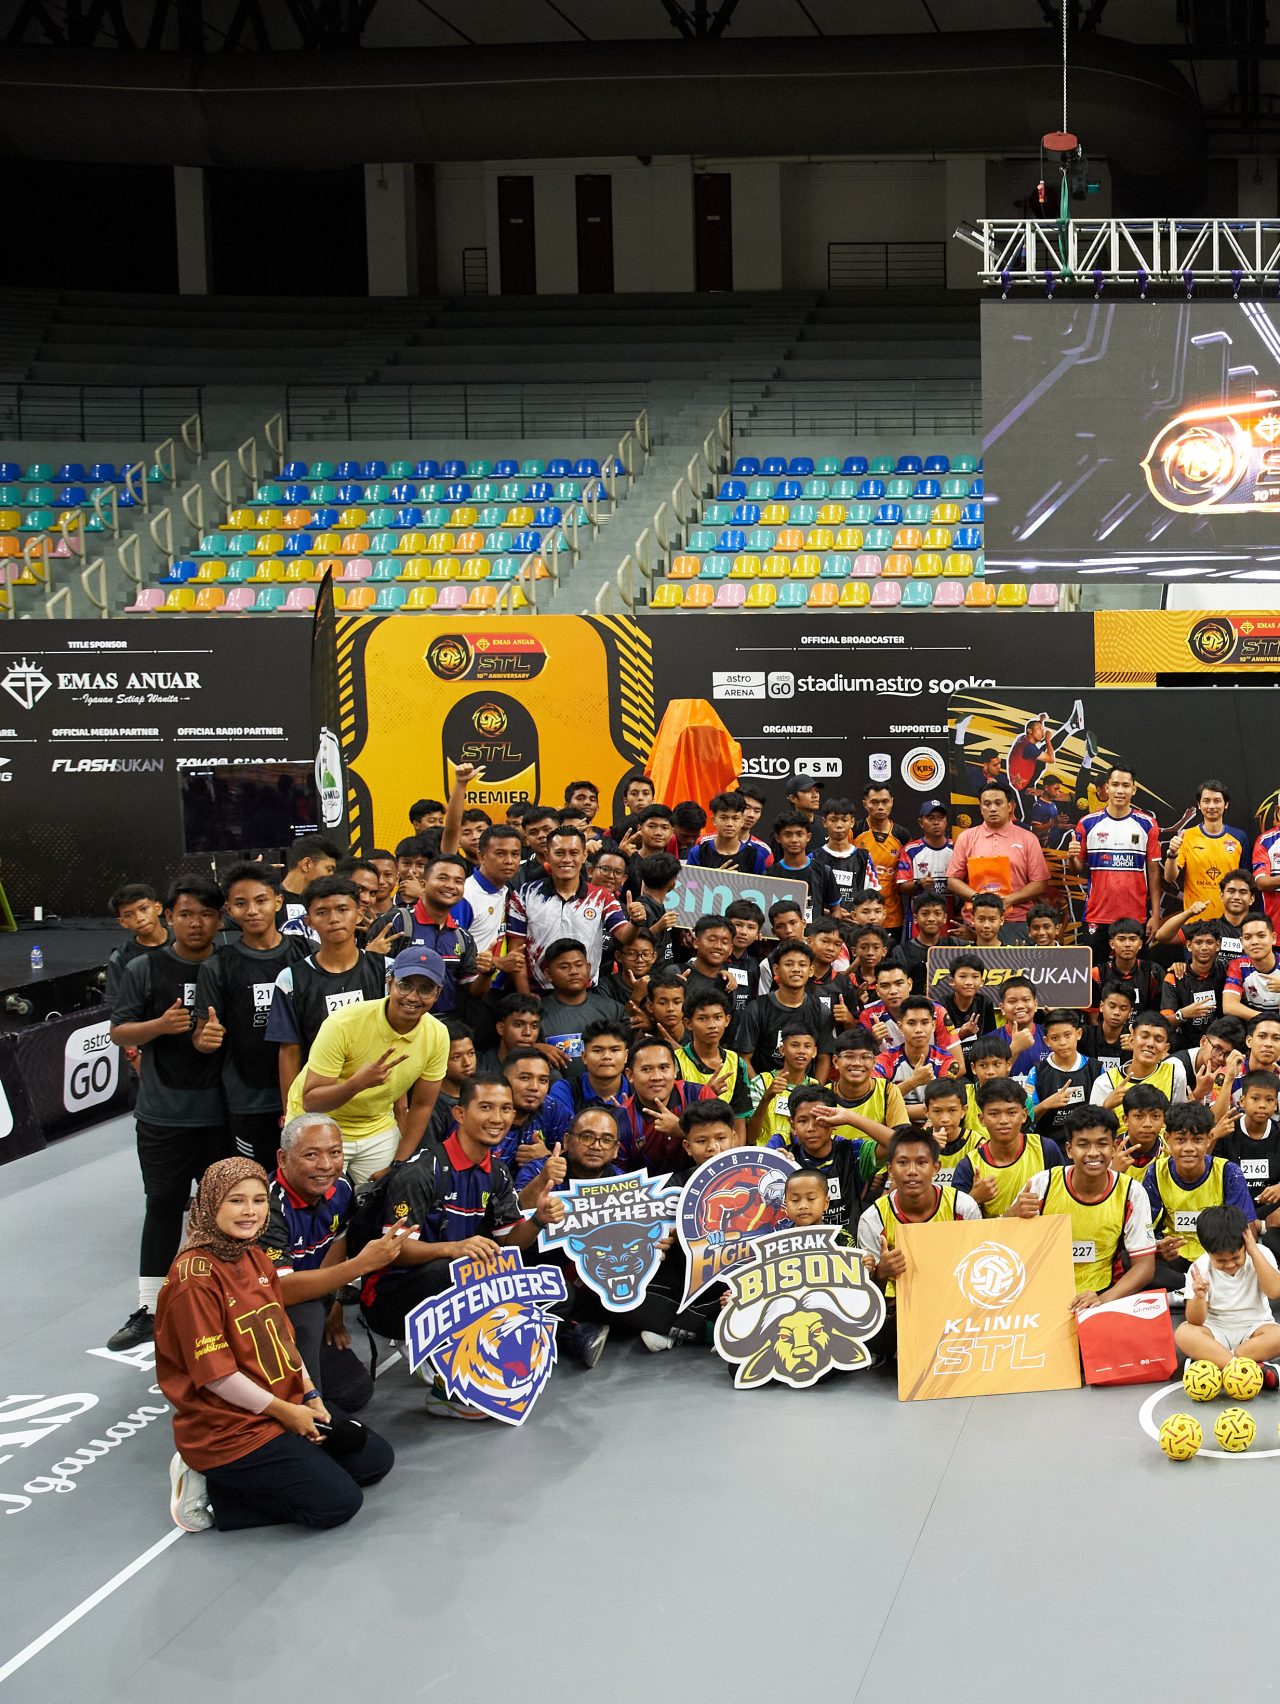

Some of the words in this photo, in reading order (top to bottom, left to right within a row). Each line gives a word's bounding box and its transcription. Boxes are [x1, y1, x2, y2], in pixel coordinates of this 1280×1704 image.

[1253, 488, 1280, 501] 10TH
[68, 641, 90, 649] TITLE
[90, 641, 127, 649] SPONSOR
[512, 638, 535, 646] ANUAR
[801, 636, 839, 644] OFFICIAL
[840, 636, 905, 644] BROADCASTER
[478, 655, 531, 672] STL
[57, 672, 119, 690] EMAS
[126, 672, 202, 689] ANUAR
[726, 674, 751, 683] astro
[724, 689, 755, 697] ARENA
[771, 683, 791, 695] GO
[116, 693, 145, 705] Setiap
[147, 693, 179, 703] Wanita
[52, 728, 90, 737] OFFICIAL
[91, 728, 119, 737] MEDIA
[120, 728, 159, 736] PARTNER
[178, 727, 215, 736] OFFICIAL
[215, 727, 243, 736] RADIO
[243, 727, 283, 736] PARTNER
[763, 725, 813, 734] ORGANIZER
[889, 725, 941, 734] SUPPORTED
[460, 741, 522, 762] STL
[741, 754, 790, 774] astro
[916, 765, 934, 773] KBS
[463, 791, 530, 804] PREMIER
[1223, 940, 1241, 949] 2198
[83, 1030, 112, 1051] astro
[70, 1055, 112, 1100] GO
[1242, 1163, 1267, 1175] 2160
[934, 1172, 953, 1183] 222
[582, 1179, 639, 1195] PENANG
[574, 1188, 650, 1212] BLACK
[549, 1196, 679, 1236] PANTHERS
[1177, 1214, 1197, 1227] 224
[765, 1233, 828, 1259] PERAK
[459, 1255, 518, 1286] PDRM
[737, 1254, 863, 1306] BISON
[415, 1271, 561, 1346] DEFENDERS
[944, 1313, 1041, 1334] KLINIK
[933, 1334, 1047, 1375] STL
